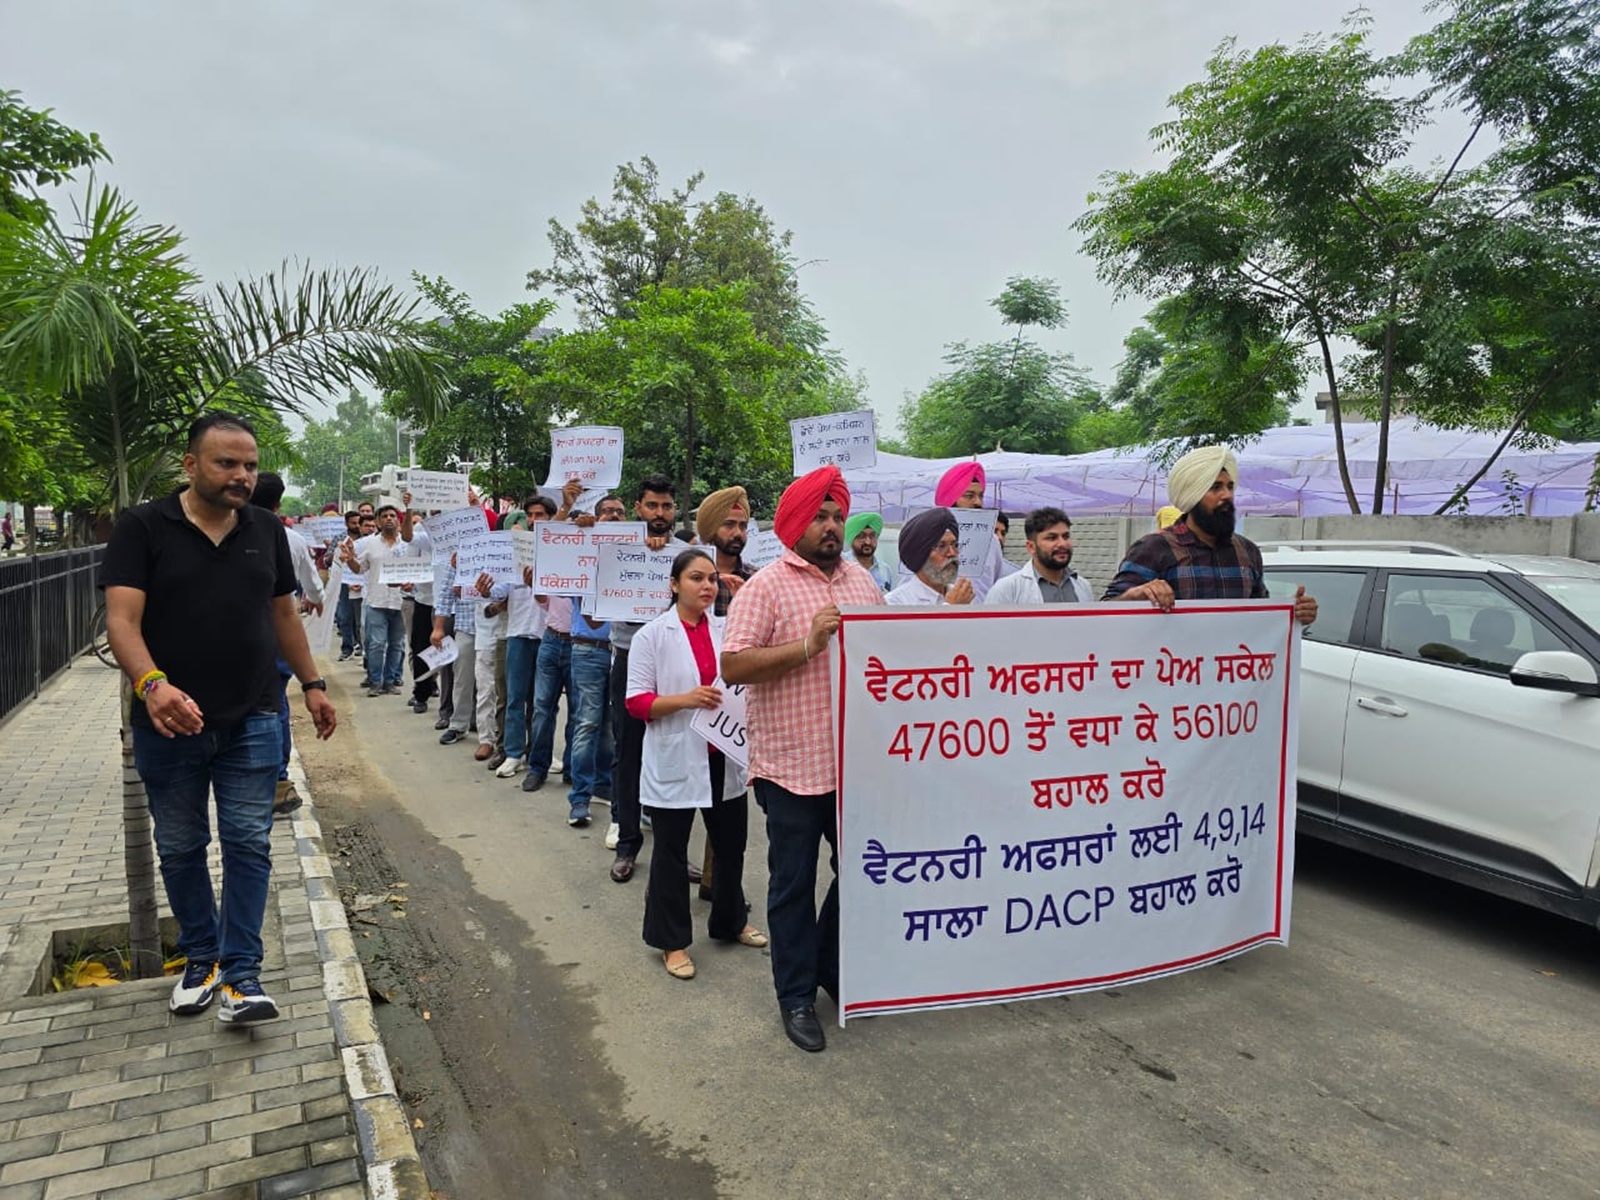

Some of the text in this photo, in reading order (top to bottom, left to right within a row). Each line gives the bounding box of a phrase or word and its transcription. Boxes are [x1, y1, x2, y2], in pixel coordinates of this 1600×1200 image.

[542, 528, 586, 545] ਵੈਟਨਰੀ
[647, 570, 670, 581] ਪੇਅ-
[650, 554, 672, 564] ਅਫਸ
[602, 589, 633, 598] 47600
[864, 645, 1276, 702] ਵੈਟਨਰੀ ਅਫਸਰਾਂ ਦਾ ਪੇਅ ਸਕੇਲ
[709, 711, 746, 747] JUS
[888, 702, 1258, 761] 47600 ਤੋਂ ਵਧਾ ਕੇ 56100
[1032, 758, 1166, 808] ਬਹਾਲ ਕਰੋ
[863, 803, 1265, 884] ਵੈਟਨਰੀ ਅਫਸਰਾਂ ਲਈ 4,9,14
[903, 855, 1242, 941] ਸਾਲਾ DACP ਬਹਾਲ ਕਰੋ
